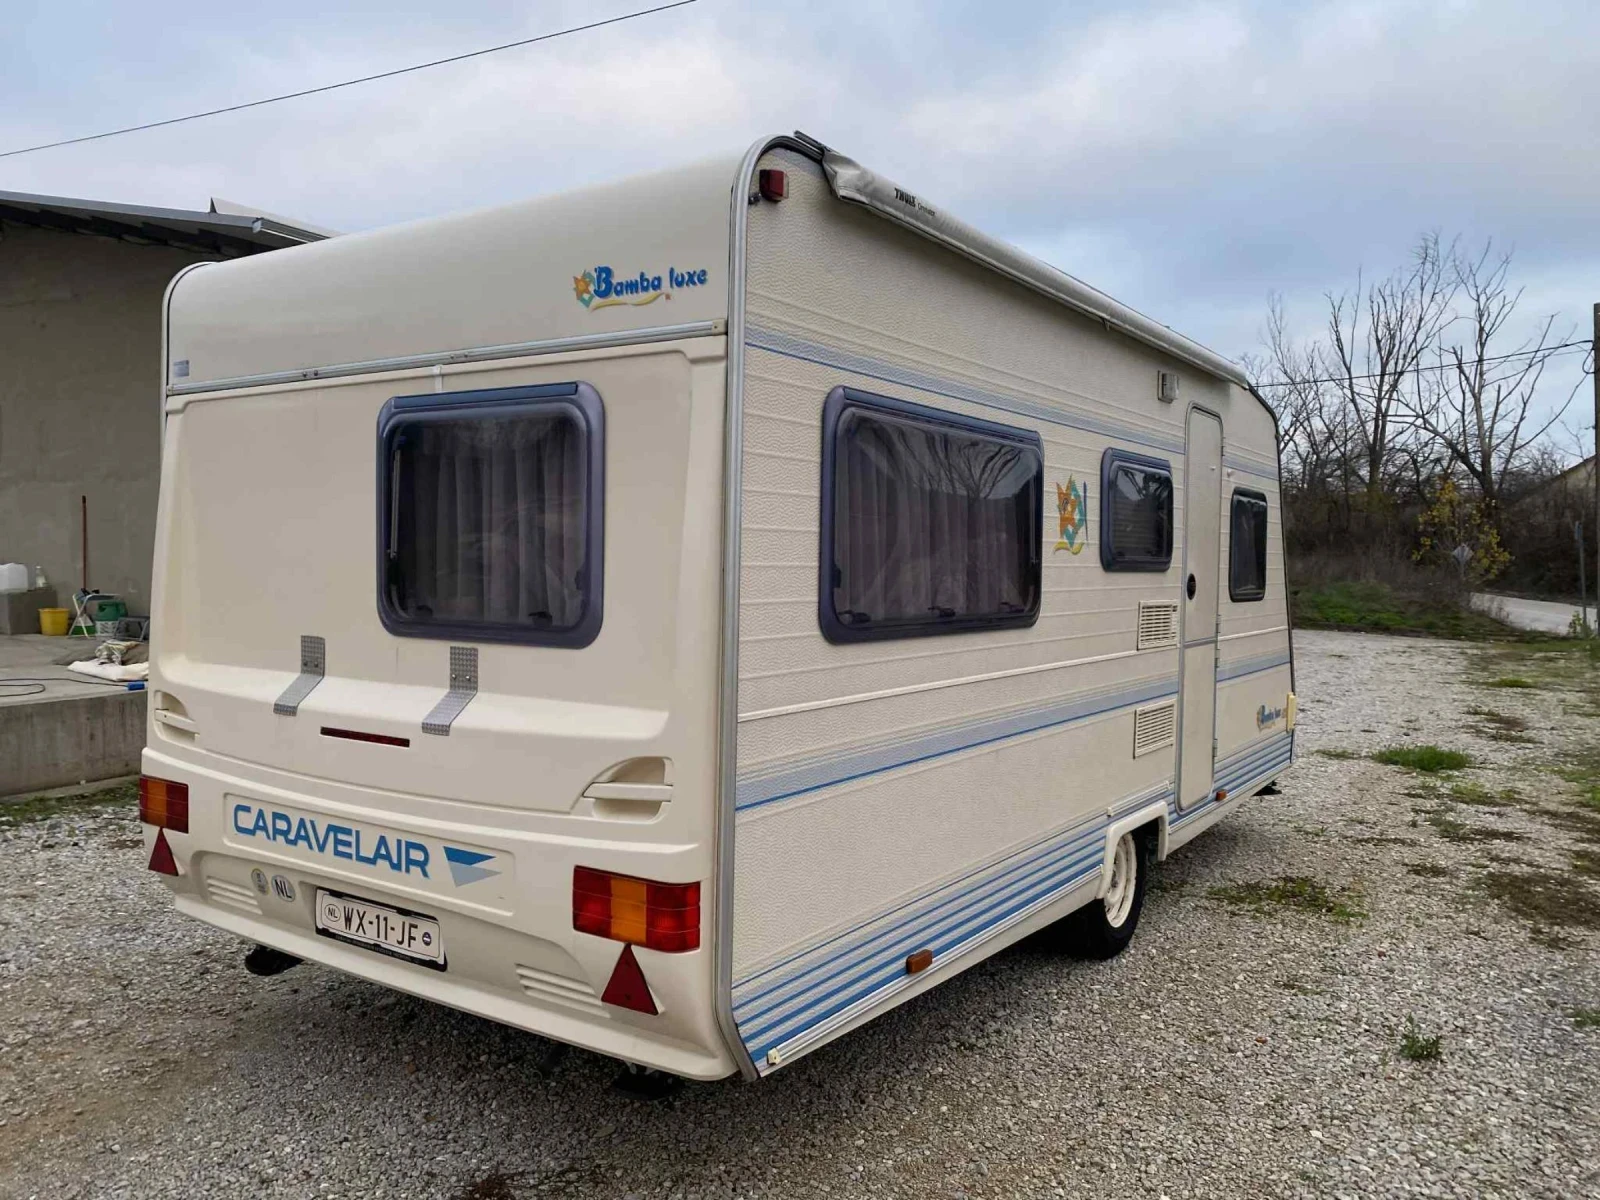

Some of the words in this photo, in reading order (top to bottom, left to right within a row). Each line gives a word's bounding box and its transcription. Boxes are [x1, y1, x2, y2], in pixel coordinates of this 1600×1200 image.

[594, 266, 662, 299] Bamba
[669, 266, 708, 290] luxe
[233, 803, 430, 879] CARAVELAIR
[274, 879, 293, 899] NL
[327, 906, 339, 919] NL
[343, 905, 418, 948] WX-11-JF
